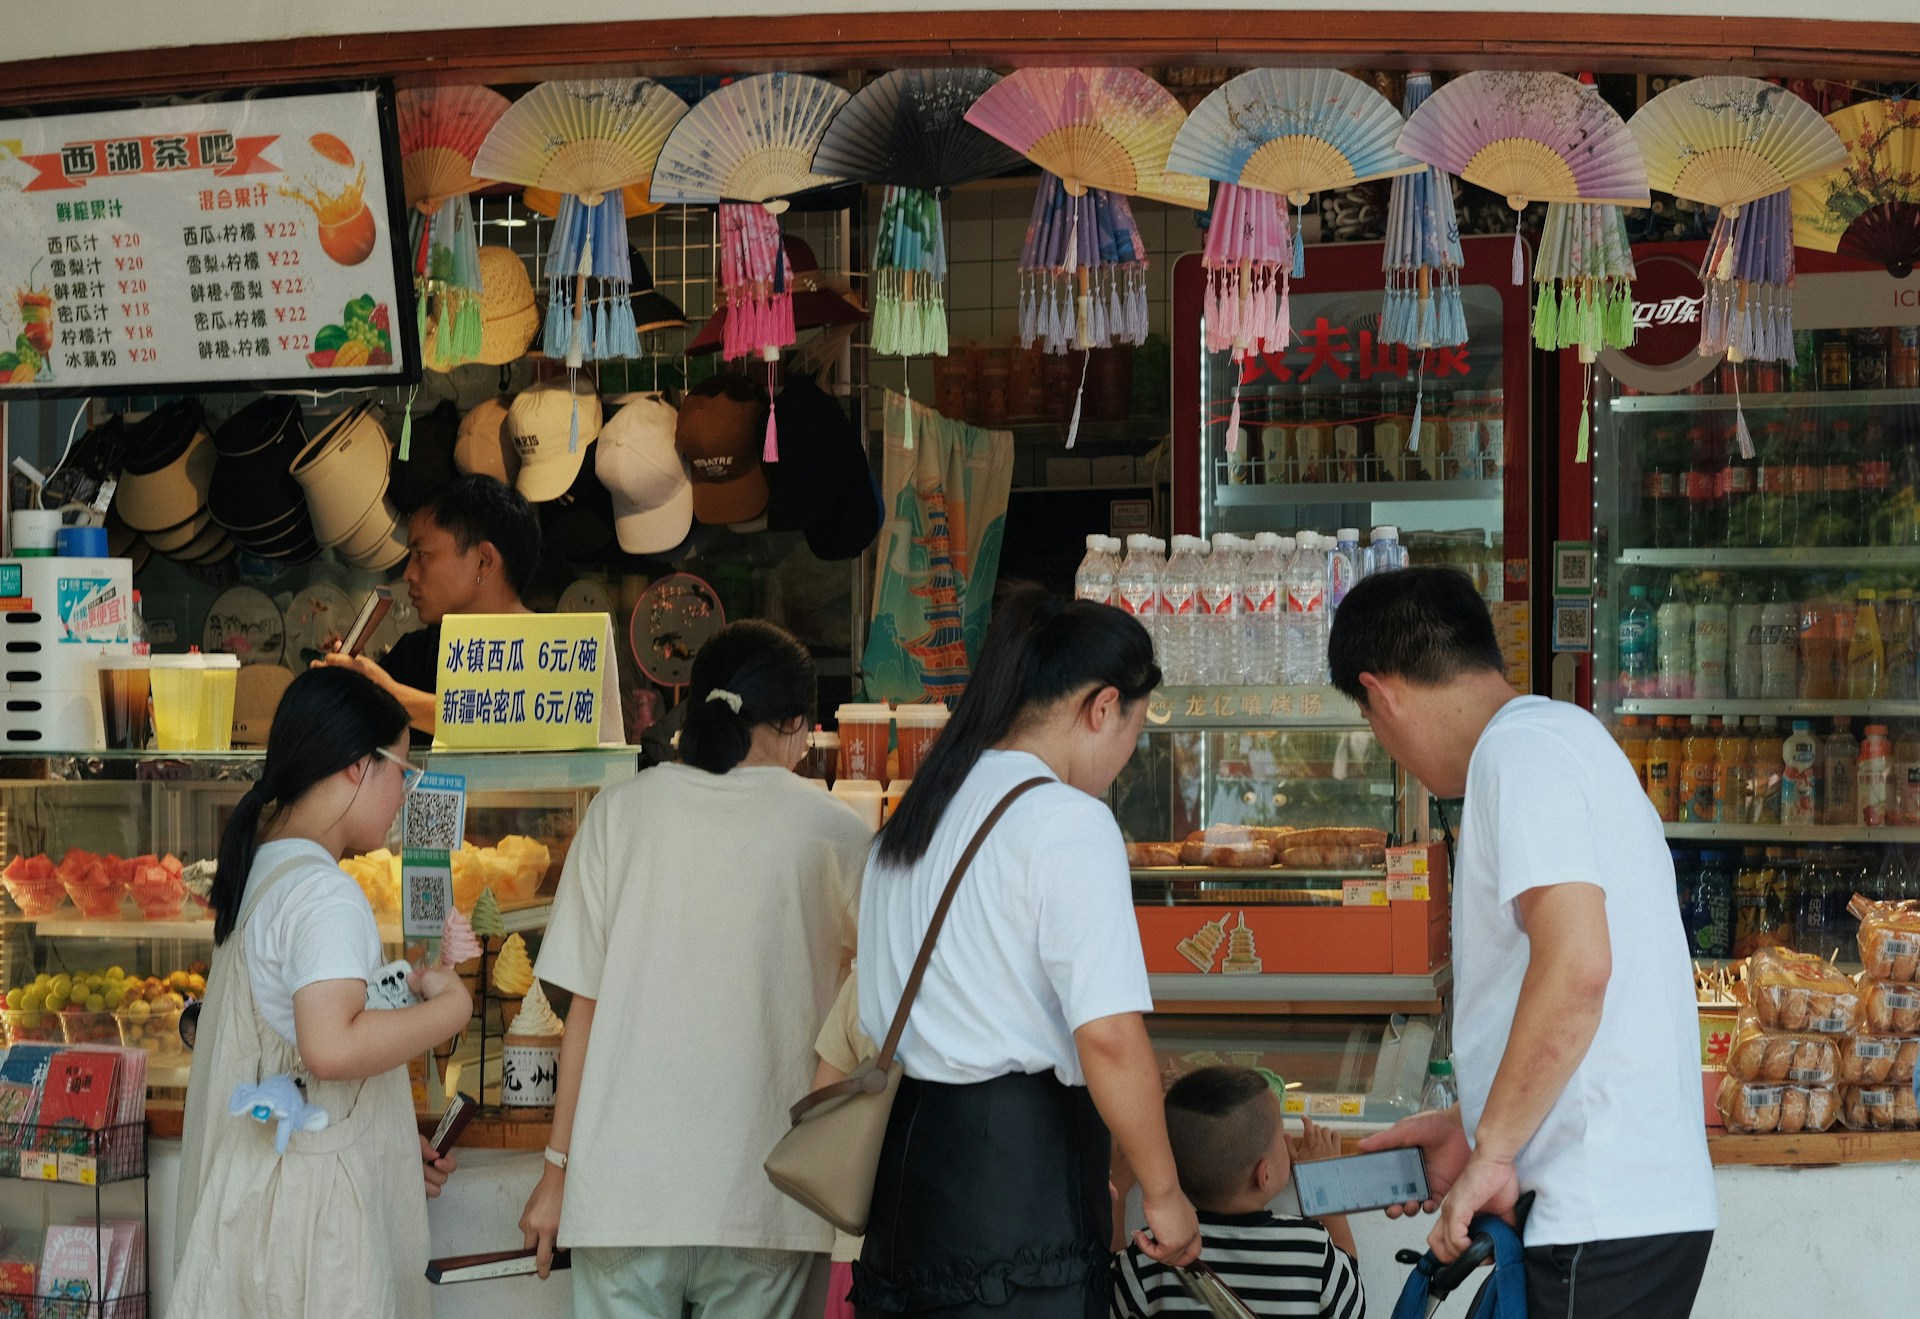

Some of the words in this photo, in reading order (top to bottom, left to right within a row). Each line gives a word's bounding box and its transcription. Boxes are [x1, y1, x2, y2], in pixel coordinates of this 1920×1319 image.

[61, 133, 237, 176] 西湖茶吧
[56, 199, 123, 222] 鲜榨果汁
[199, 187, 268, 211] 混合果汁
[47, 234, 100, 254] 西瓜汁
[112, 233, 140, 249] ¥20
[183, 223, 257, 246] 西瓜+柠檬
[264, 222, 297, 238] ¥22
[51, 257, 102, 277] 雪梨汁
[115, 256, 143, 271] ¥20
[186, 251, 260, 275] 雪梨+柠檬
[267, 251, 299, 266] ¥22
[54, 280, 106, 301] 鲜橙汁
[118, 280, 146, 295] ¥20
[190, 280, 264, 303] 鲜橙+雪梨
[271, 279, 303, 295] ¥22
[1894, 289, 1920, 307] IC
[57, 303, 110, 324] 密瓜汁
[121, 302, 150, 317] ¥18
[194, 308, 267, 330] 密瓜+柠檬
[275, 307, 306, 323] ¥22
[61, 327, 114, 347] 柠檬汁
[125, 325, 153, 340] ¥18
[198, 337, 272, 359] 鲜橙+柠檬
[278, 335, 310, 351] ¥22
[65, 349, 117, 368] 冰藕粉
[128, 348, 157, 363] ¥20
[446, 638, 525, 673] 冰镇西瓜
[538, 637, 598, 672] 6元/碗
[442, 688, 526, 724] 新疆哈密瓜
[534, 688, 594, 724] 6元/碗
